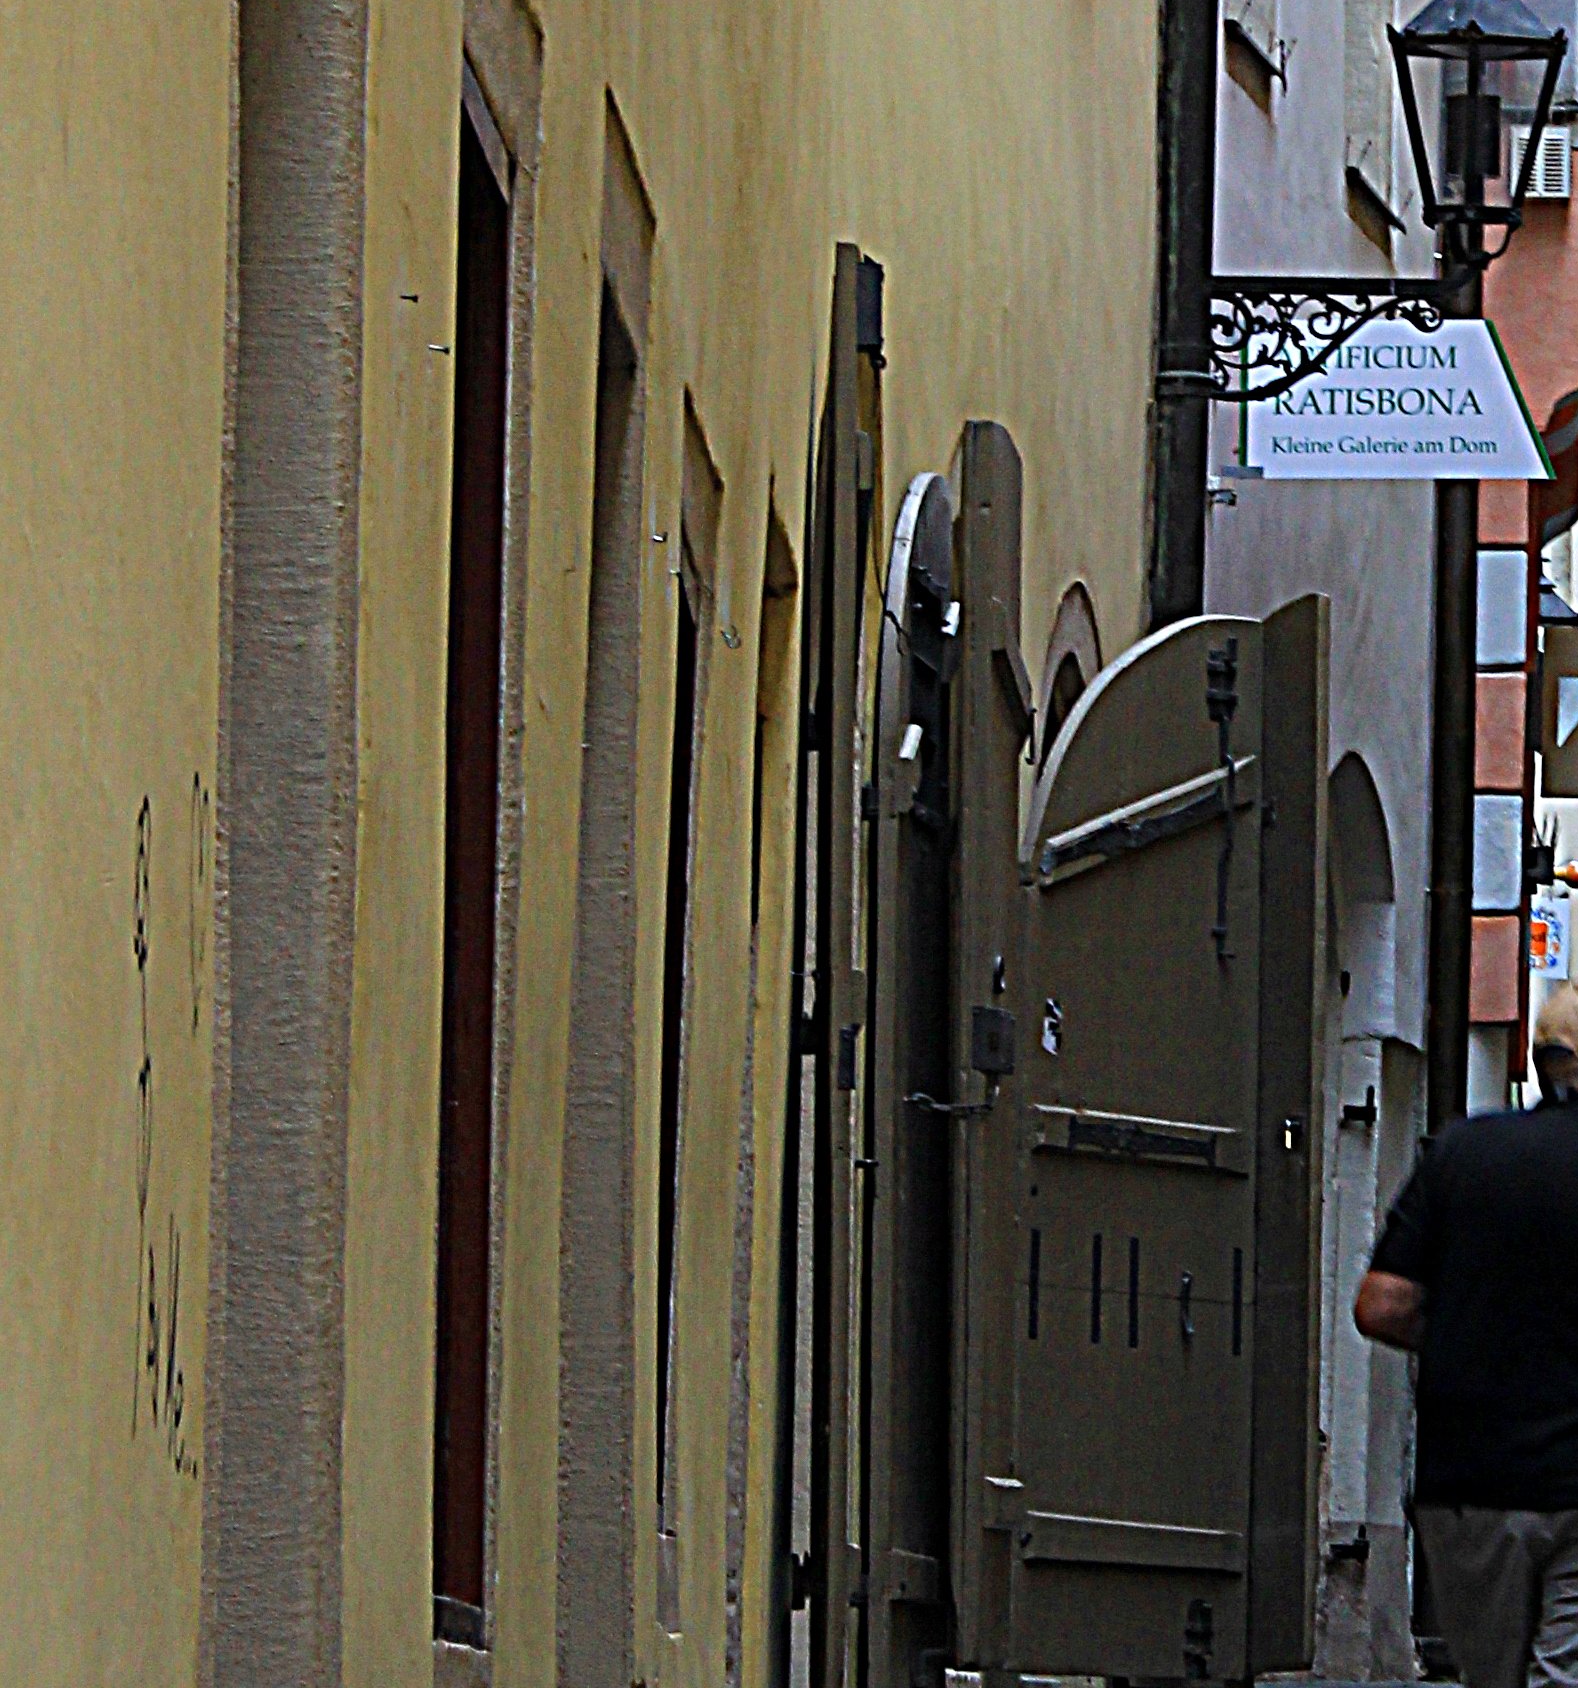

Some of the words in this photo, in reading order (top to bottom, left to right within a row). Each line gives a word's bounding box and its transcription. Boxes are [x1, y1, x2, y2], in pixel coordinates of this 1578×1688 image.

[1272, 387, 1484, 416] RATISBONA
[1271, 435, 1333, 454] Kleine
[1338, 435, 1408, 454] Galerie
[1413, 440, 1445, 454] am
[1449, 435, 1498, 454] Dom
